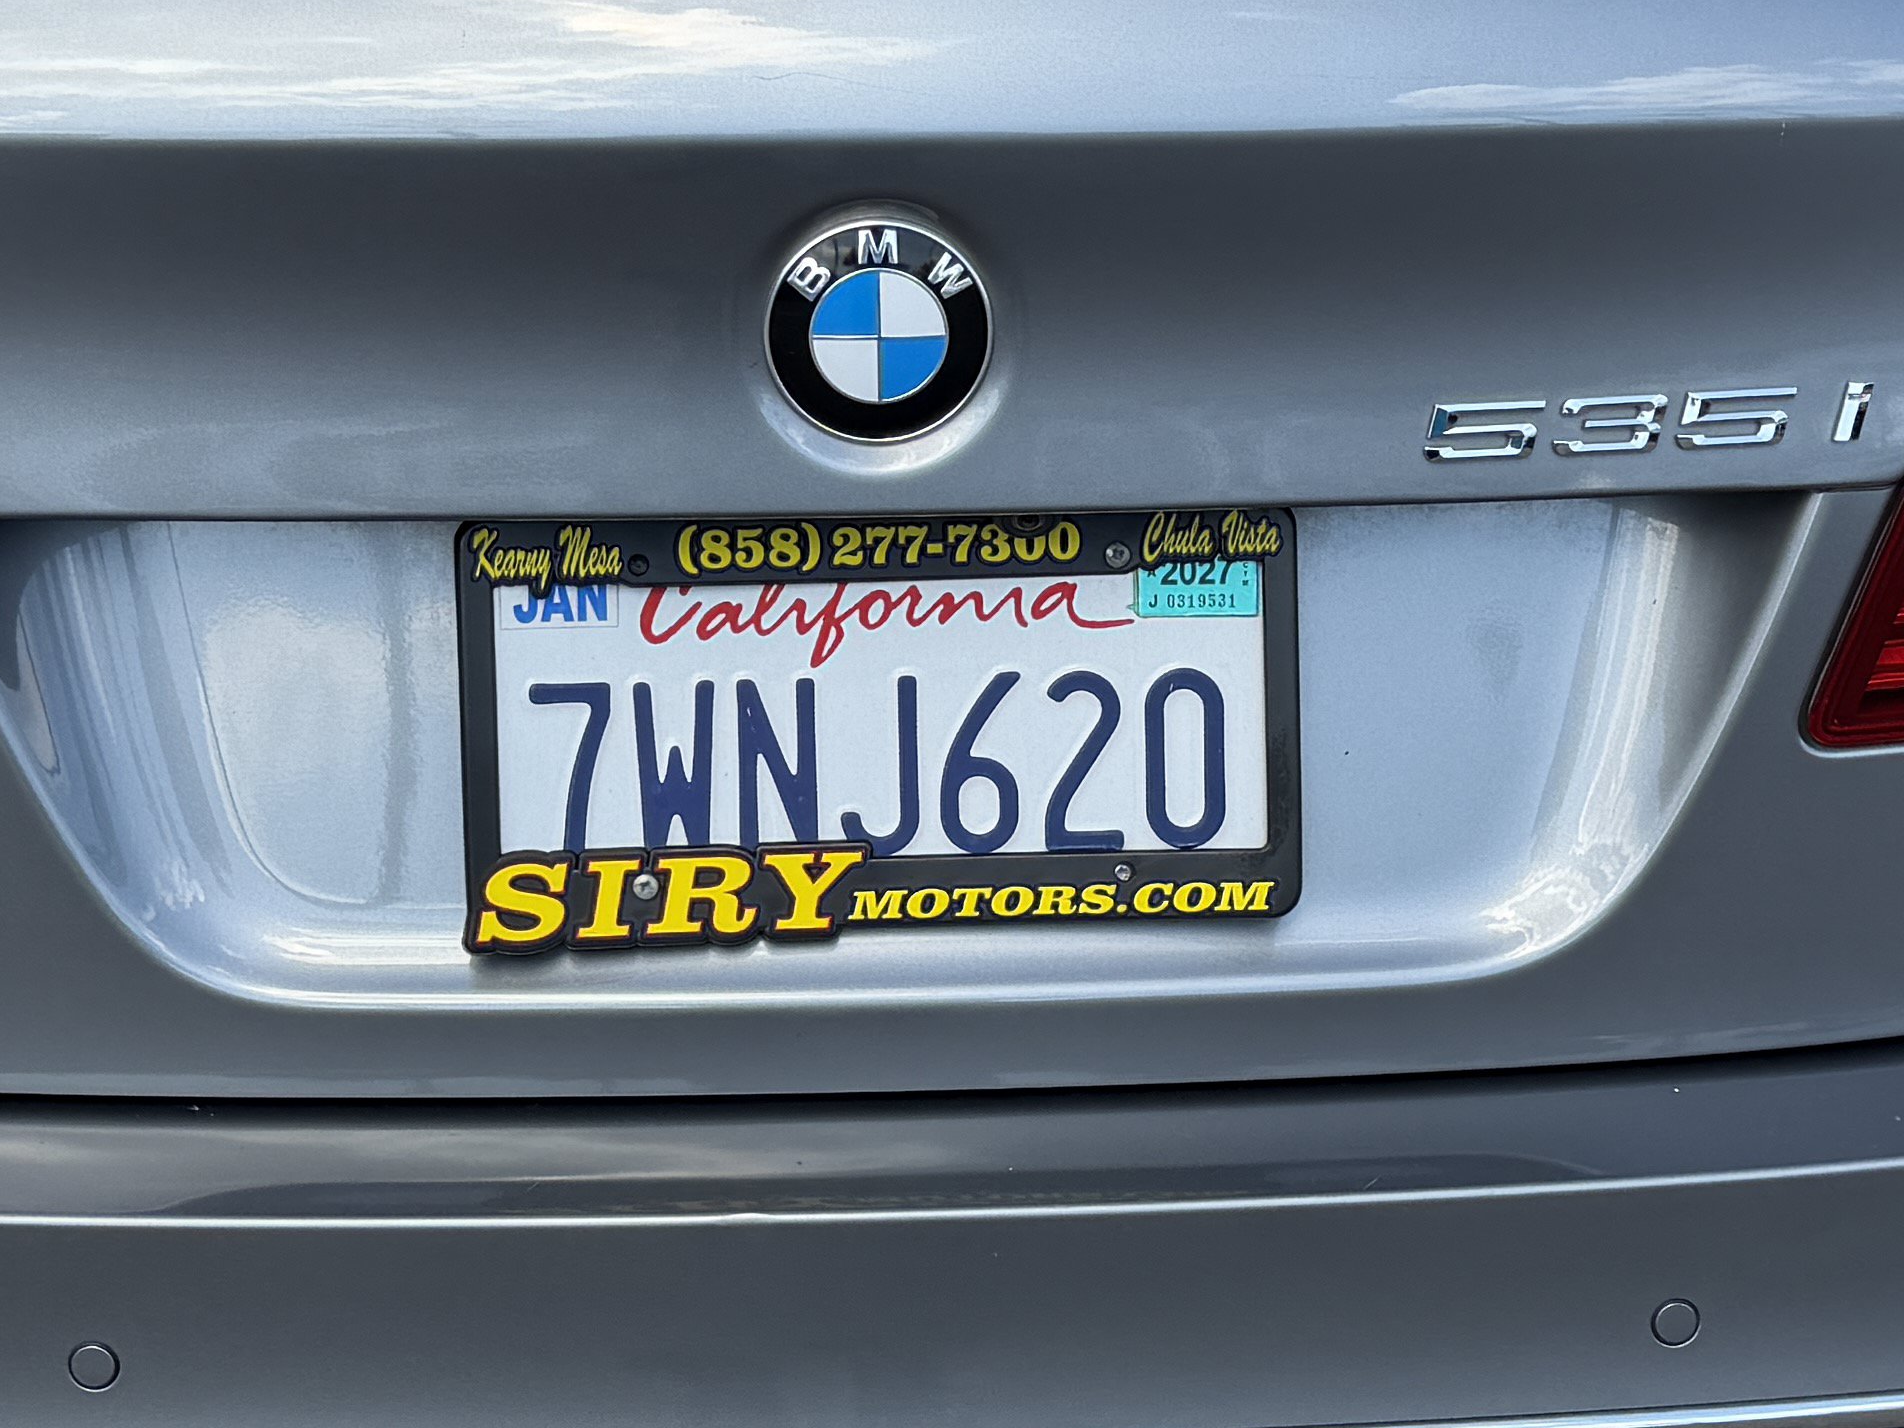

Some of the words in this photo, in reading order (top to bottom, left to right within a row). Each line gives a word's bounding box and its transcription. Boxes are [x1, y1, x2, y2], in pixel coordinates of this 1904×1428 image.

[786, 228, 974, 302] BMW
[472, 527, 552, 590] Kearny
[559, 524, 623, 578] Mesa
[678, 521, 821, 573] (858)
[832, 521, 1081, 567] 277-7300
[1143, 511, 1214, 563] Chula
[1222, 510, 1281, 554] Vista
[1160, 560, 1233, 586] 2027
[512, 584, 609, 624] JAN
[639, 580, 1135, 669] California
[1167, 593, 1236, 609] 0319531
[528, 668, 1225, 855] 7WNJ620
[476, 850, 865, 943] SIRY
[848, 880, 1275, 921] MOTORS.COM
